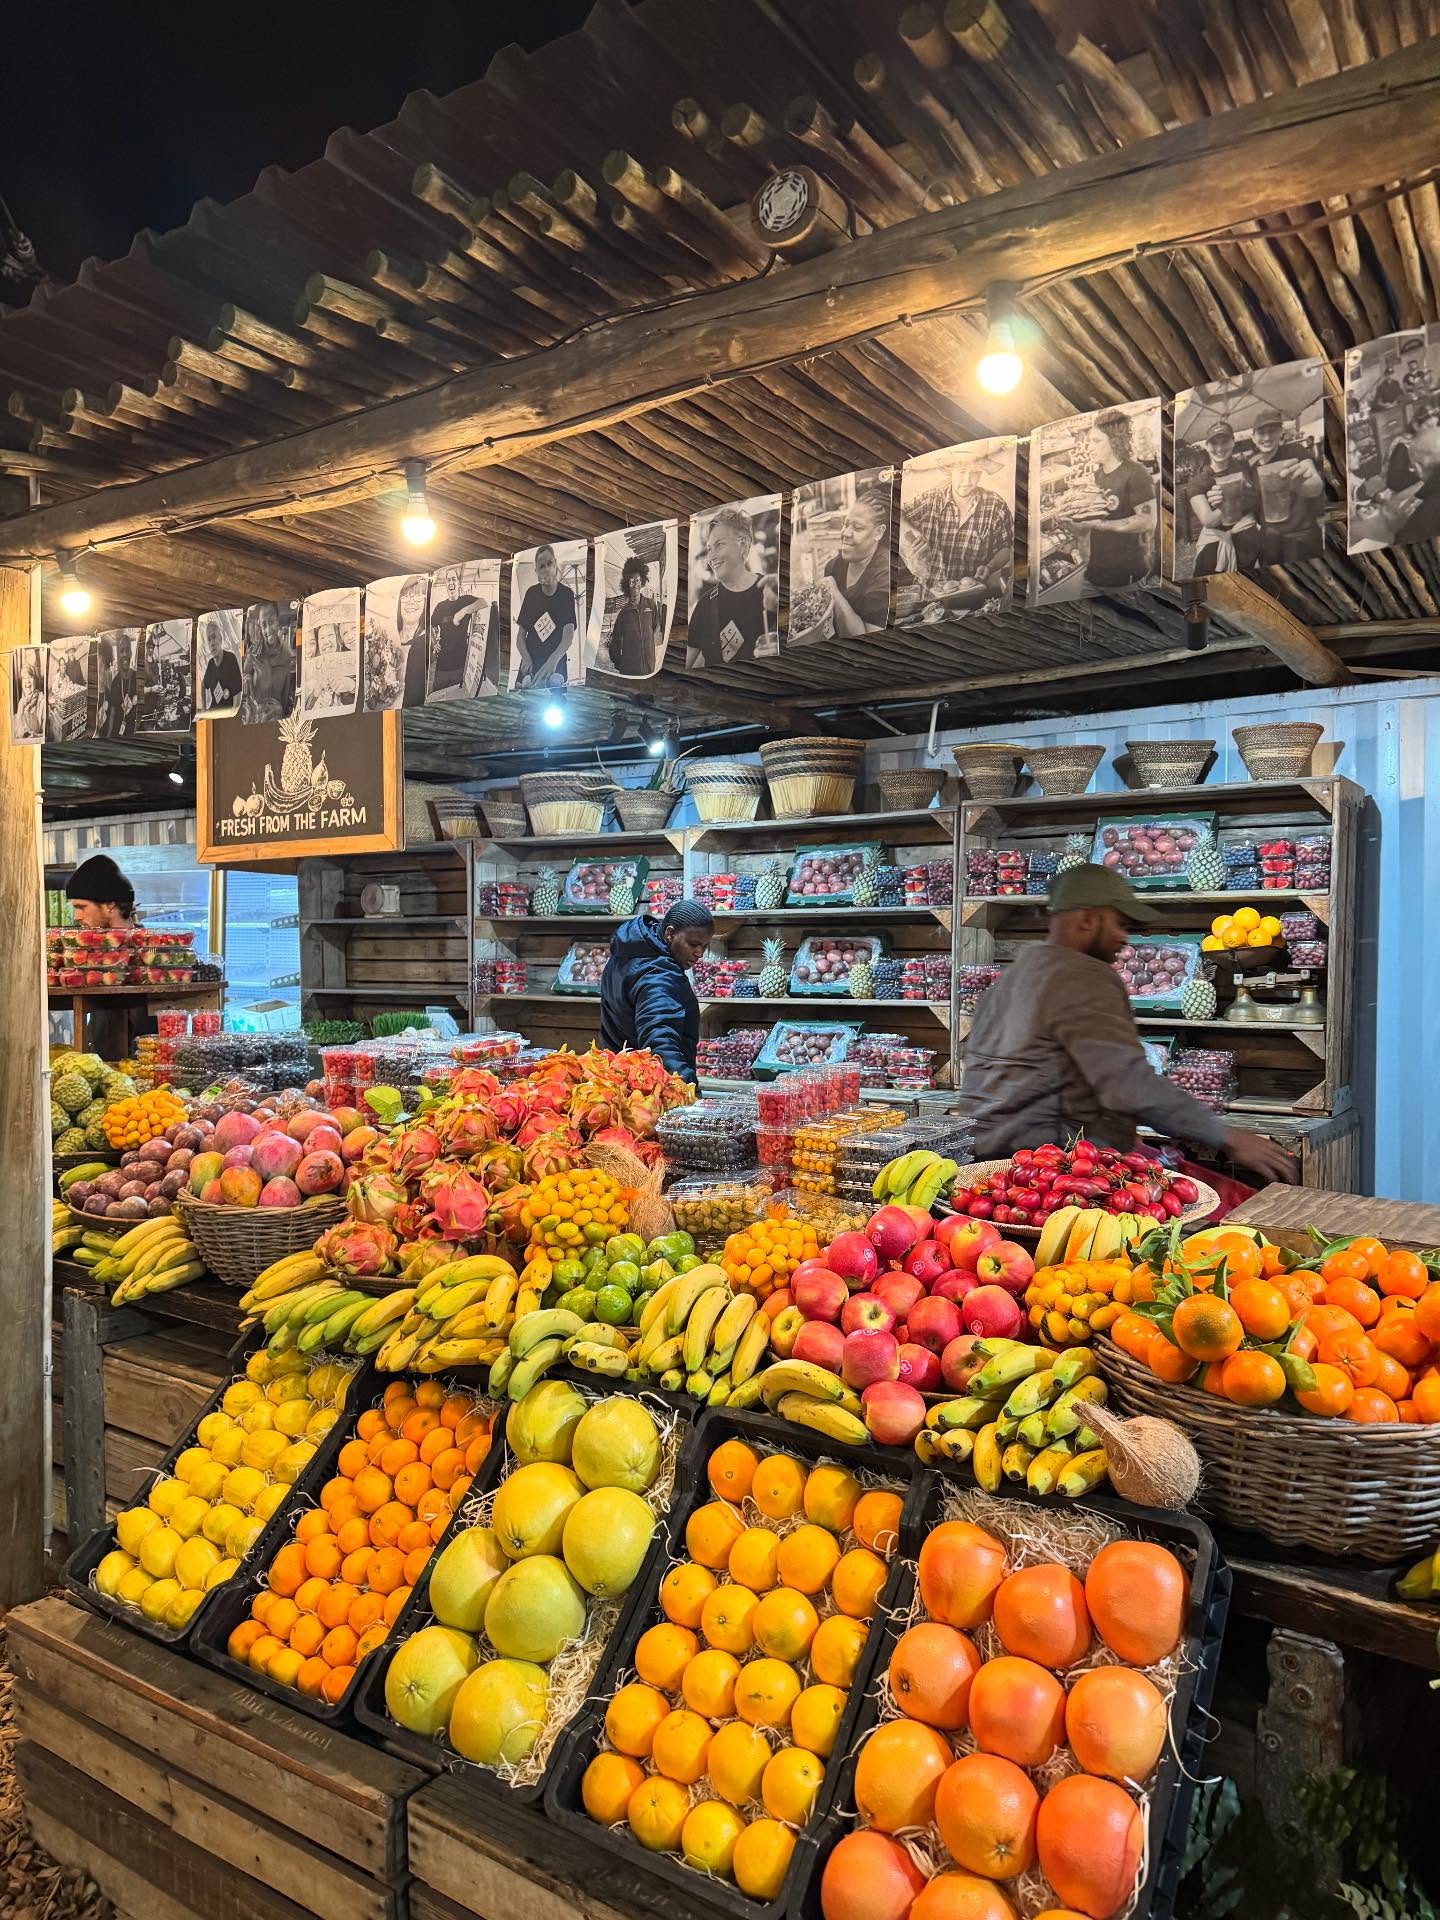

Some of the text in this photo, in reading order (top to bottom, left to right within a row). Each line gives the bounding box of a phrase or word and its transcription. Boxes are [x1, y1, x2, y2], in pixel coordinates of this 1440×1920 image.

[220, 806, 367, 837] FRESH FROM THE FARM
